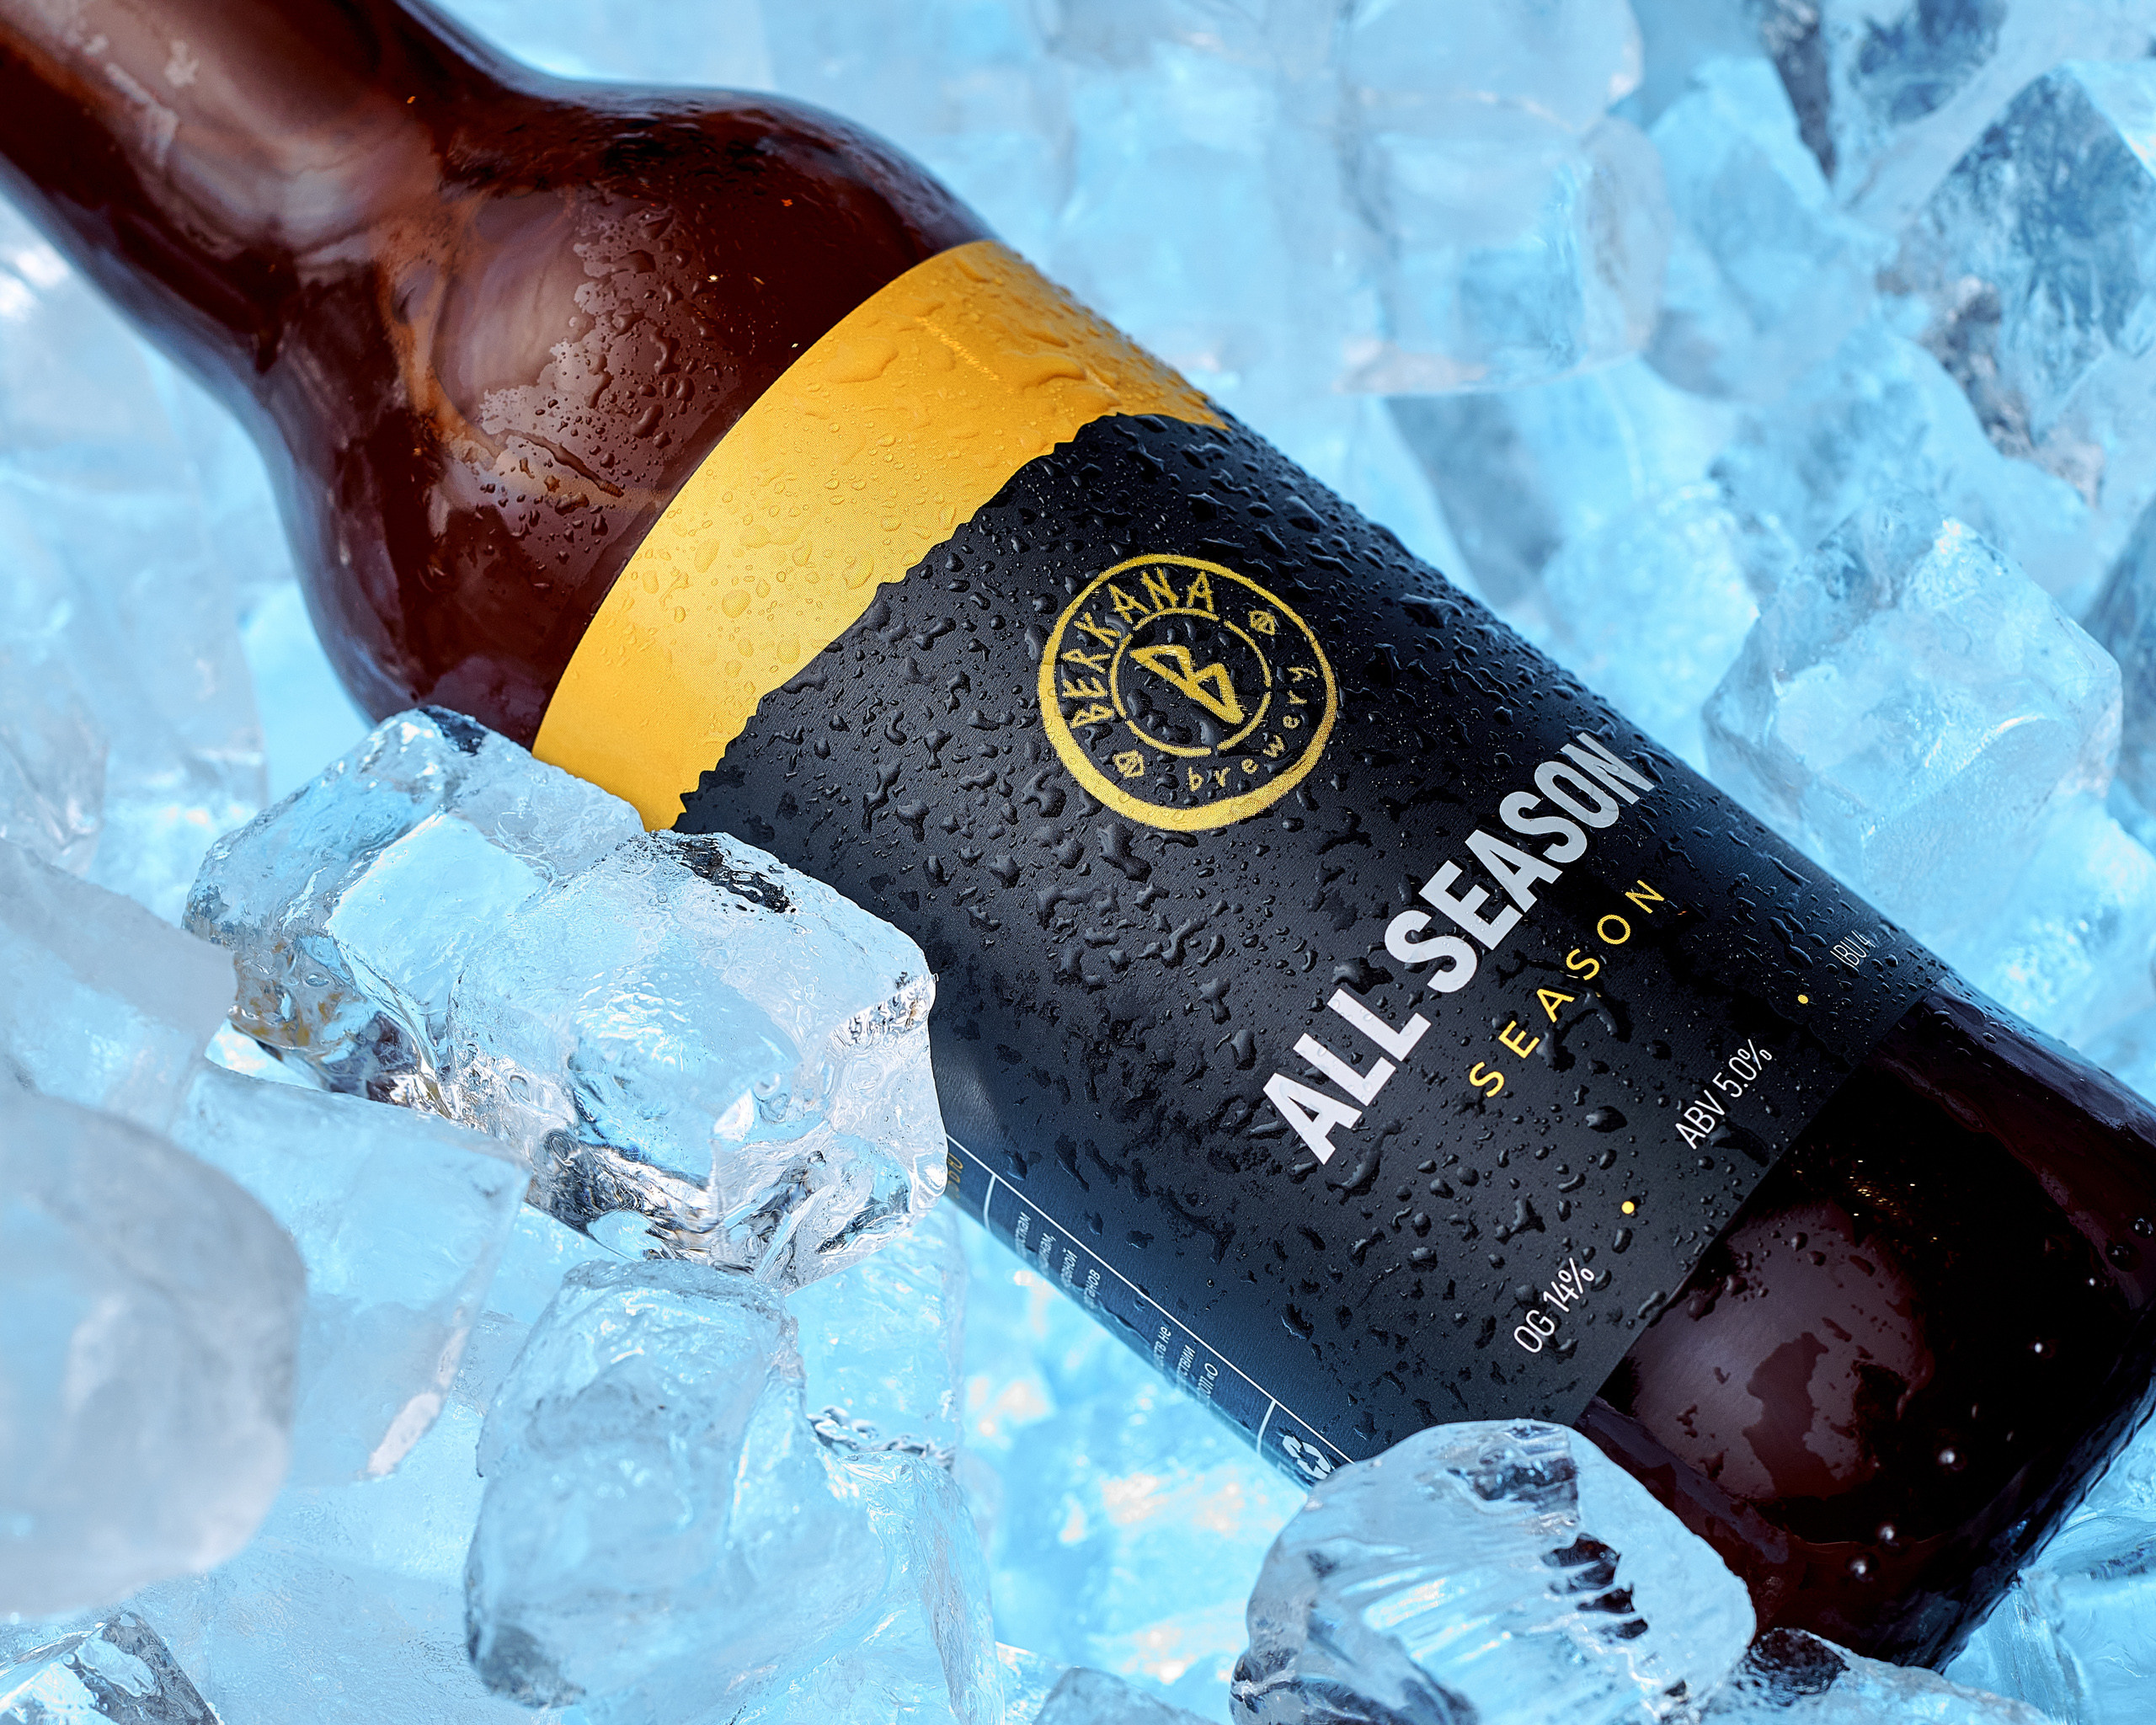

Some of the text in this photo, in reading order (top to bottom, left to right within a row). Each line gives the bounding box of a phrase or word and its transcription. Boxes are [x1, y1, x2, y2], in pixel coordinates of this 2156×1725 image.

[1061, 568, 1214, 729] BERKANA
[1187, 666, 1318, 792] brewery
[1263, 732, 1655, 1165] ALL SEASON
[1469, 879, 1664, 1097] SEASON
[1830, 937, 1867, 971] IBU
[1675, 1039, 1773, 1149] ABV 5.0%
[1157, 1327, 1171, 1343] не
[1513, 1258, 1594, 1353] OG 14%
